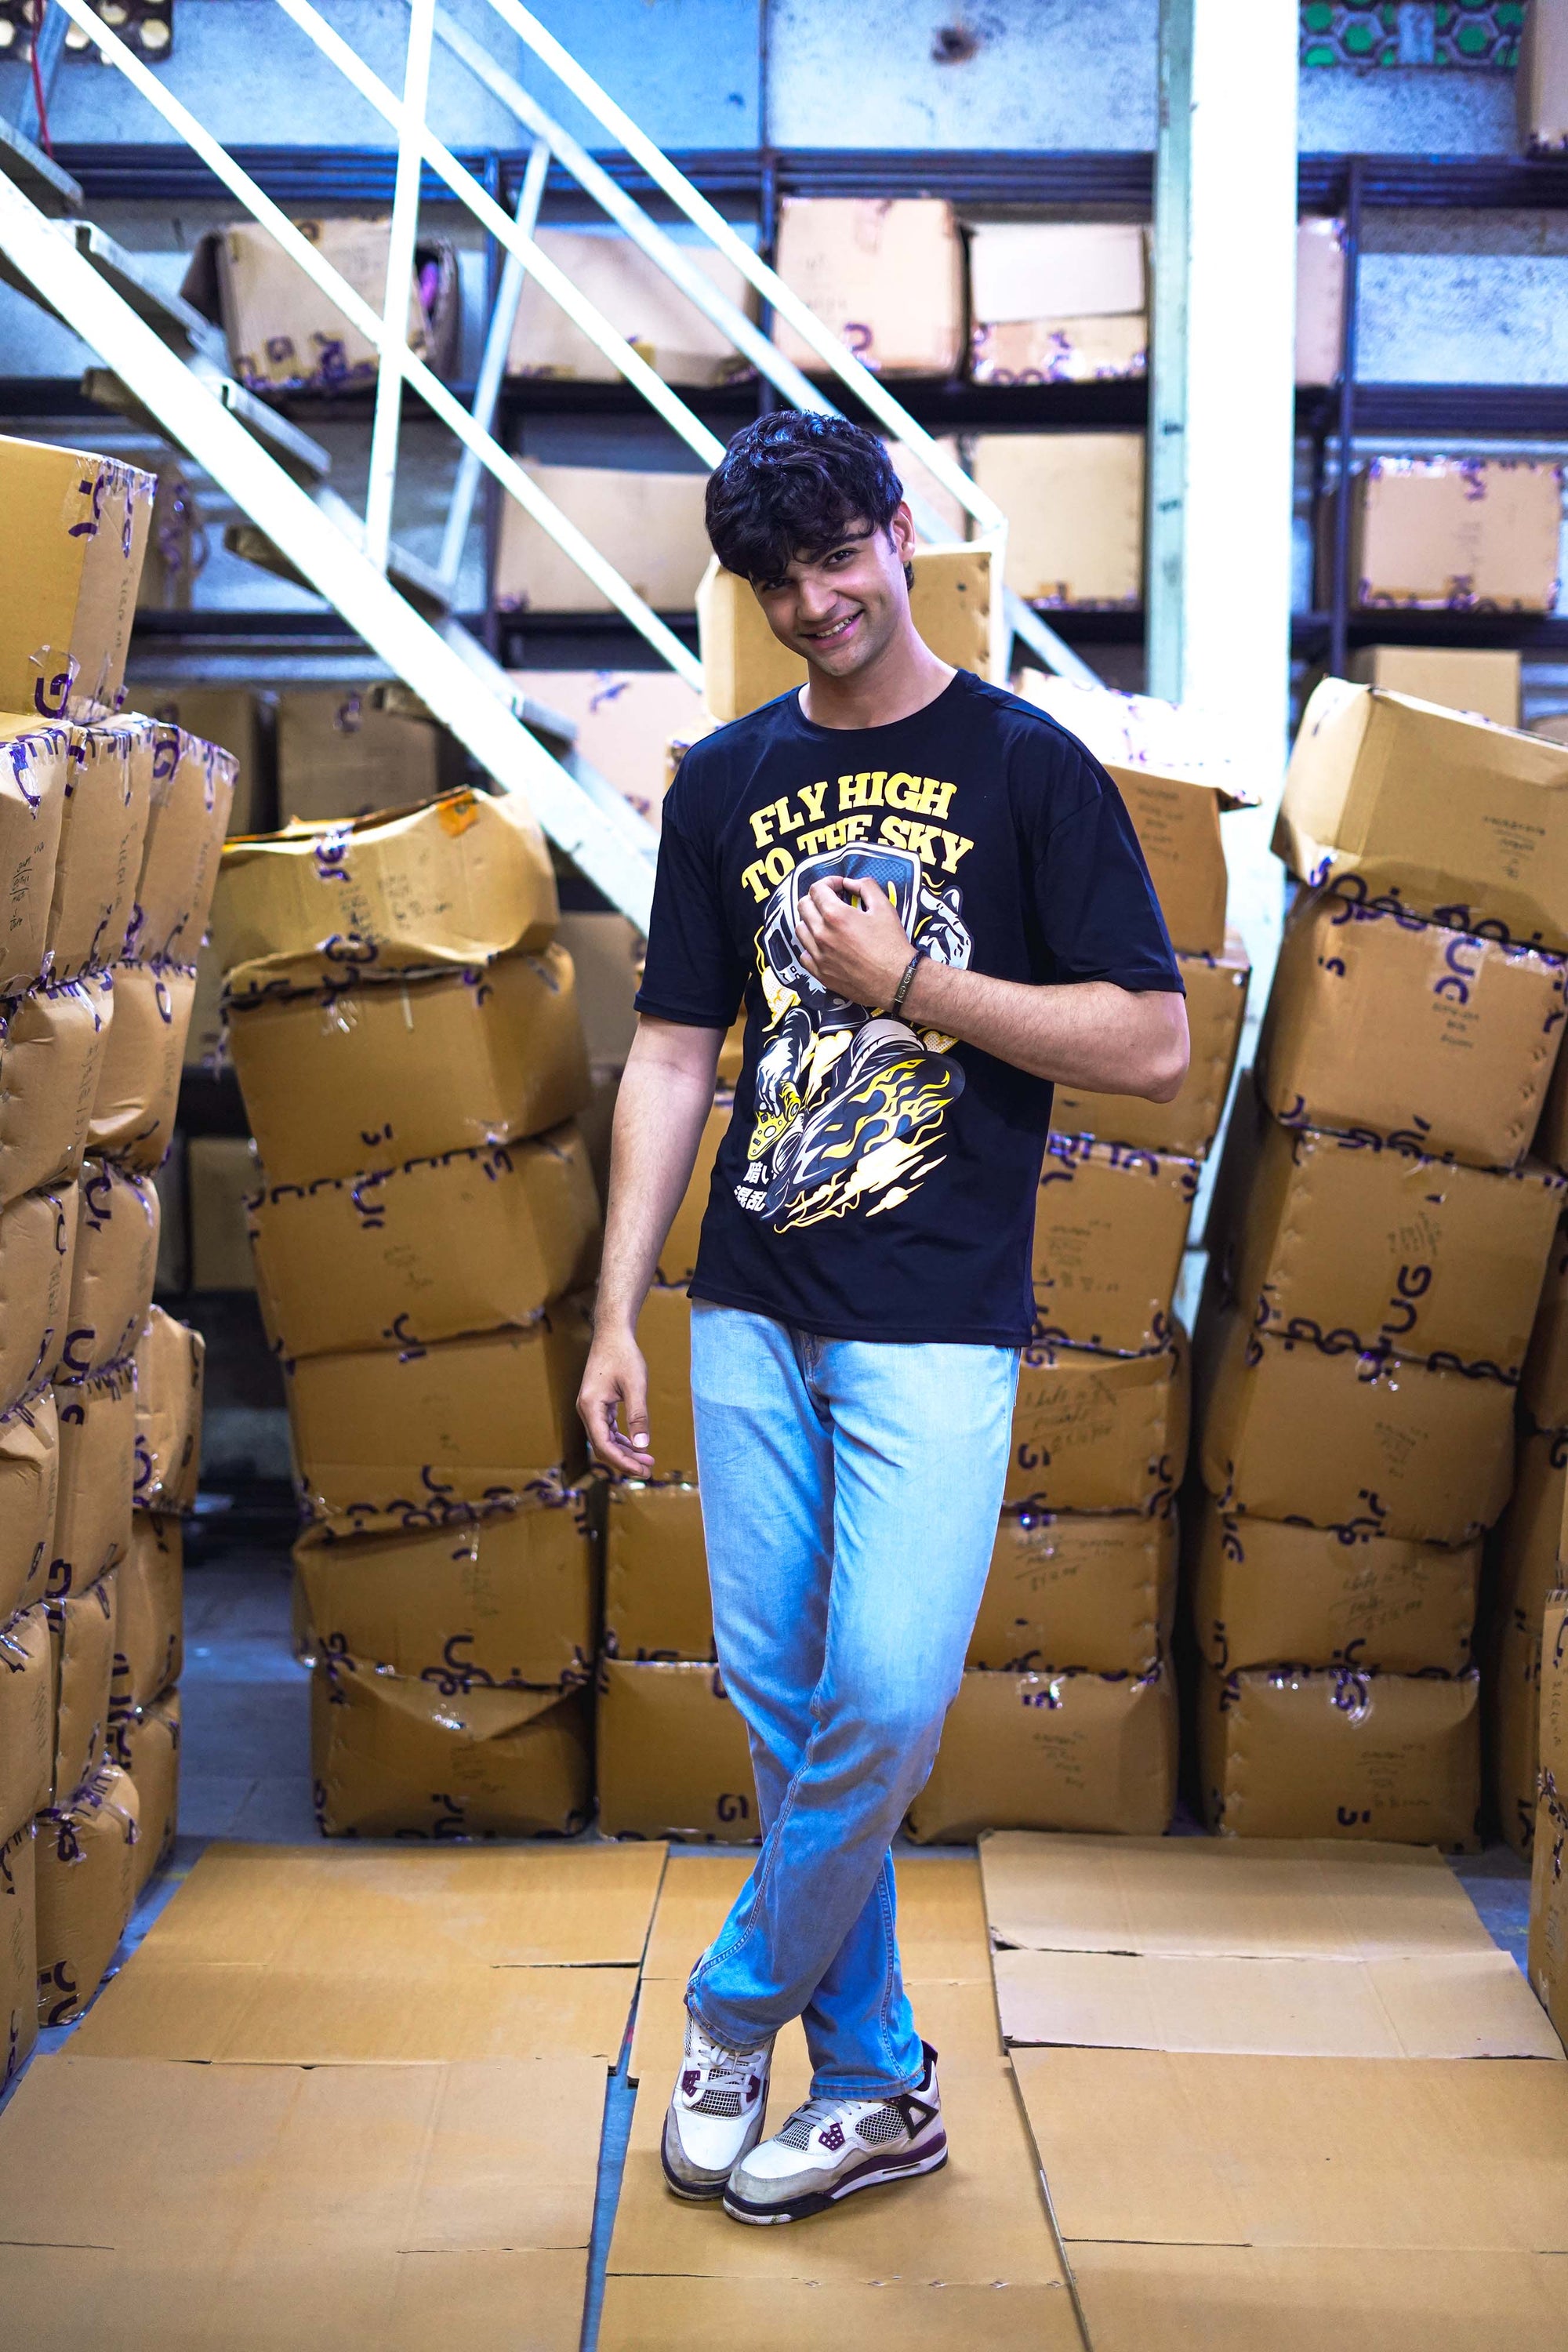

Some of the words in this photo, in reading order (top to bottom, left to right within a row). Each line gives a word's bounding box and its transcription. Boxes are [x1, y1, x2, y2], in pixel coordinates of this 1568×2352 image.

[749, 781, 829, 849] FLY
[837, 771, 958, 821] HIGH
[741, 847, 796, 903] TO
[796, 814, 873, 856] THE
[877, 815, 975, 874] SKY
